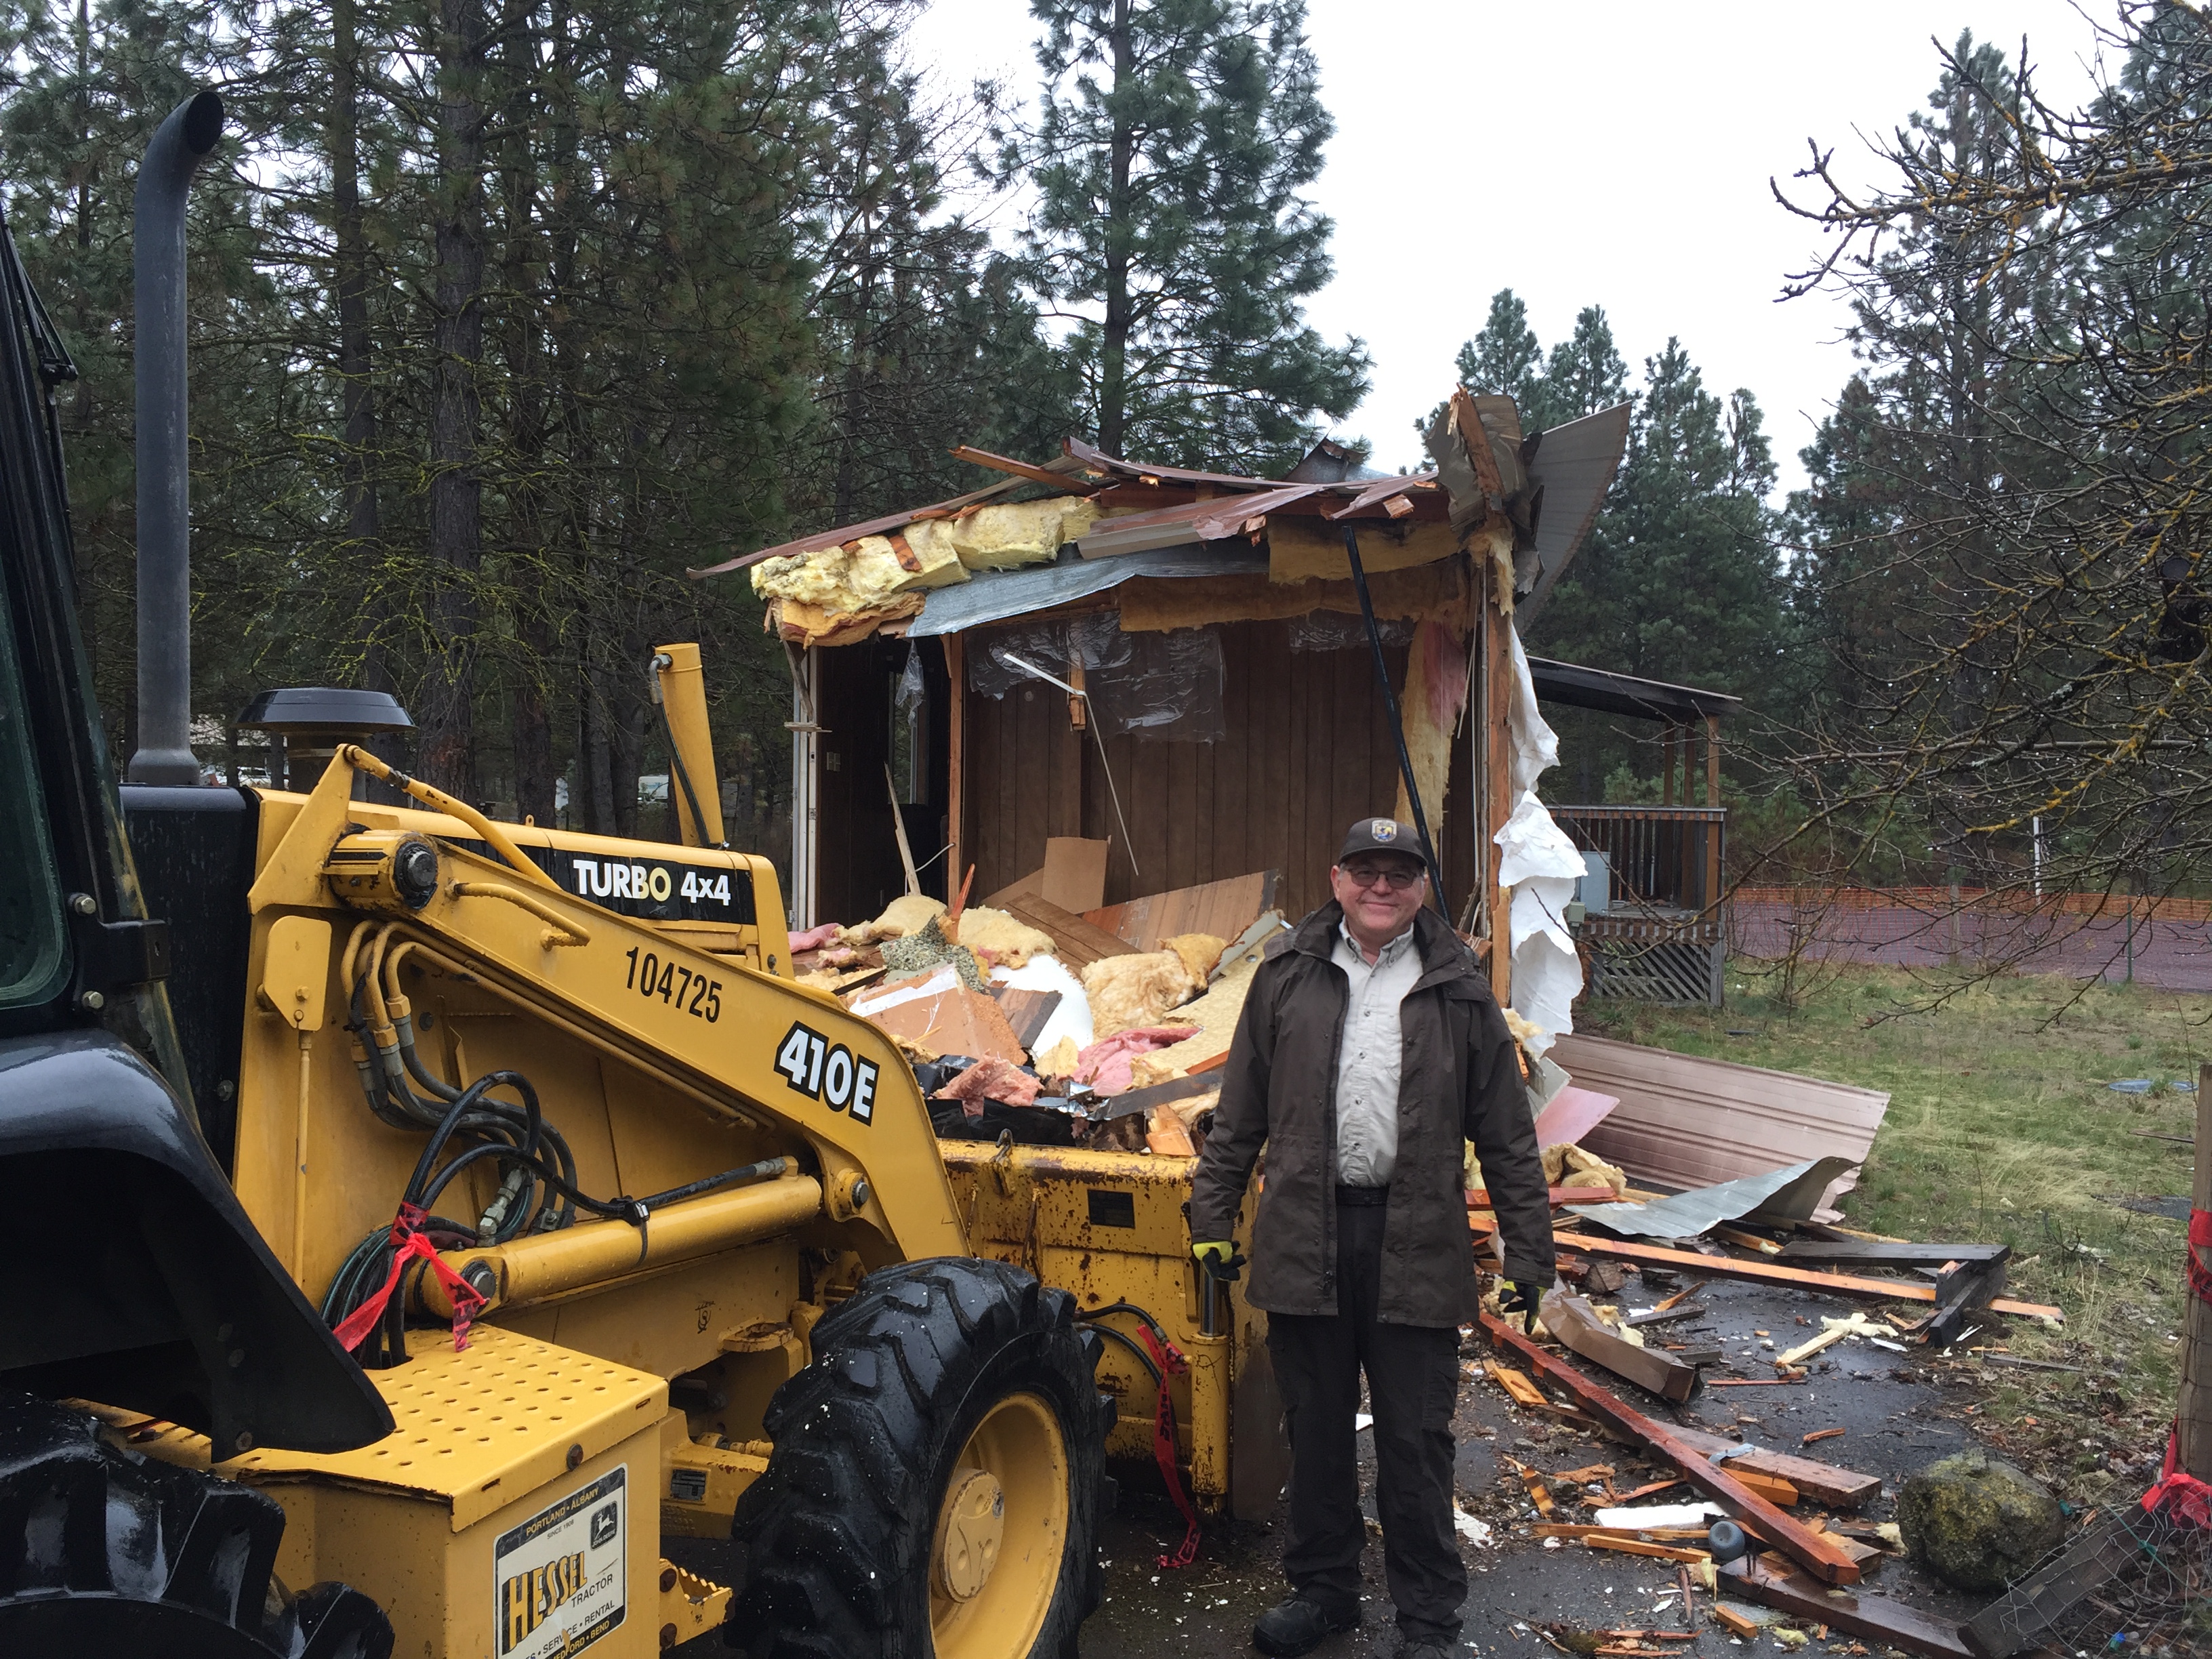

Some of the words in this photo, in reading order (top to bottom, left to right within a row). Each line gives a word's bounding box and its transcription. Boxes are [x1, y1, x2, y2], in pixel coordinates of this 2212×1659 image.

[573, 859, 671, 902] TURBO
[680, 871, 731, 906] 4x4
[626, 946, 722, 1023] 104725
[779, 1027, 877, 1120] 410E
[526, 1507, 565, 1536] PORTLAND
[571, 1487, 599, 1511] ALBANY
[547, 1526, 562, 1540] SINCE
[508, 1551, 588, 1652] HESSEL
[571, 1573, 613, 1607] TRACTOR
[543, 1623, 577, 1654] SERVCE
[584, 1601, 615, 1626] RENTAL
[590, 1620, 610, 1639] BEND
